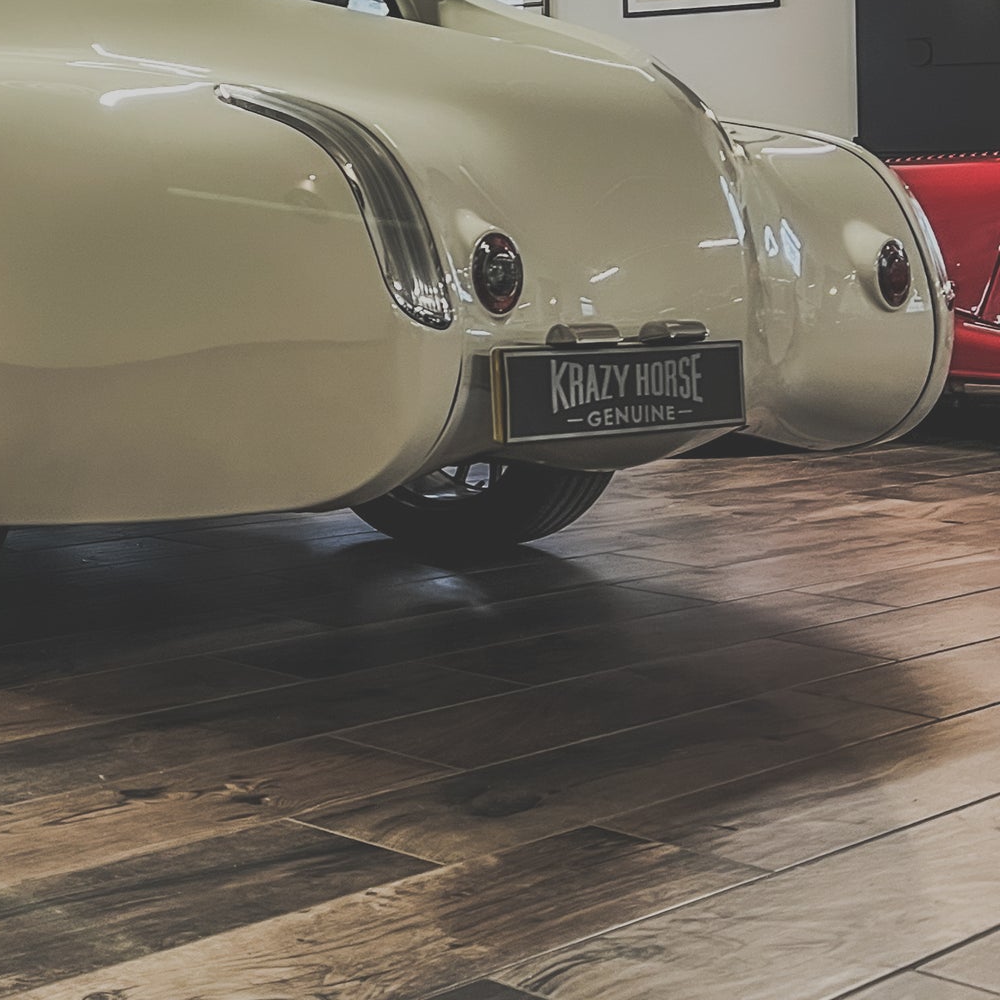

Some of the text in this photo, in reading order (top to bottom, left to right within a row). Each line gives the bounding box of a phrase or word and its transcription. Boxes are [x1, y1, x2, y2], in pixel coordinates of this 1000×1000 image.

[550, 353, 703, 414] KRAZY HORSE
[587, 404, 676, 427] GENUINE
